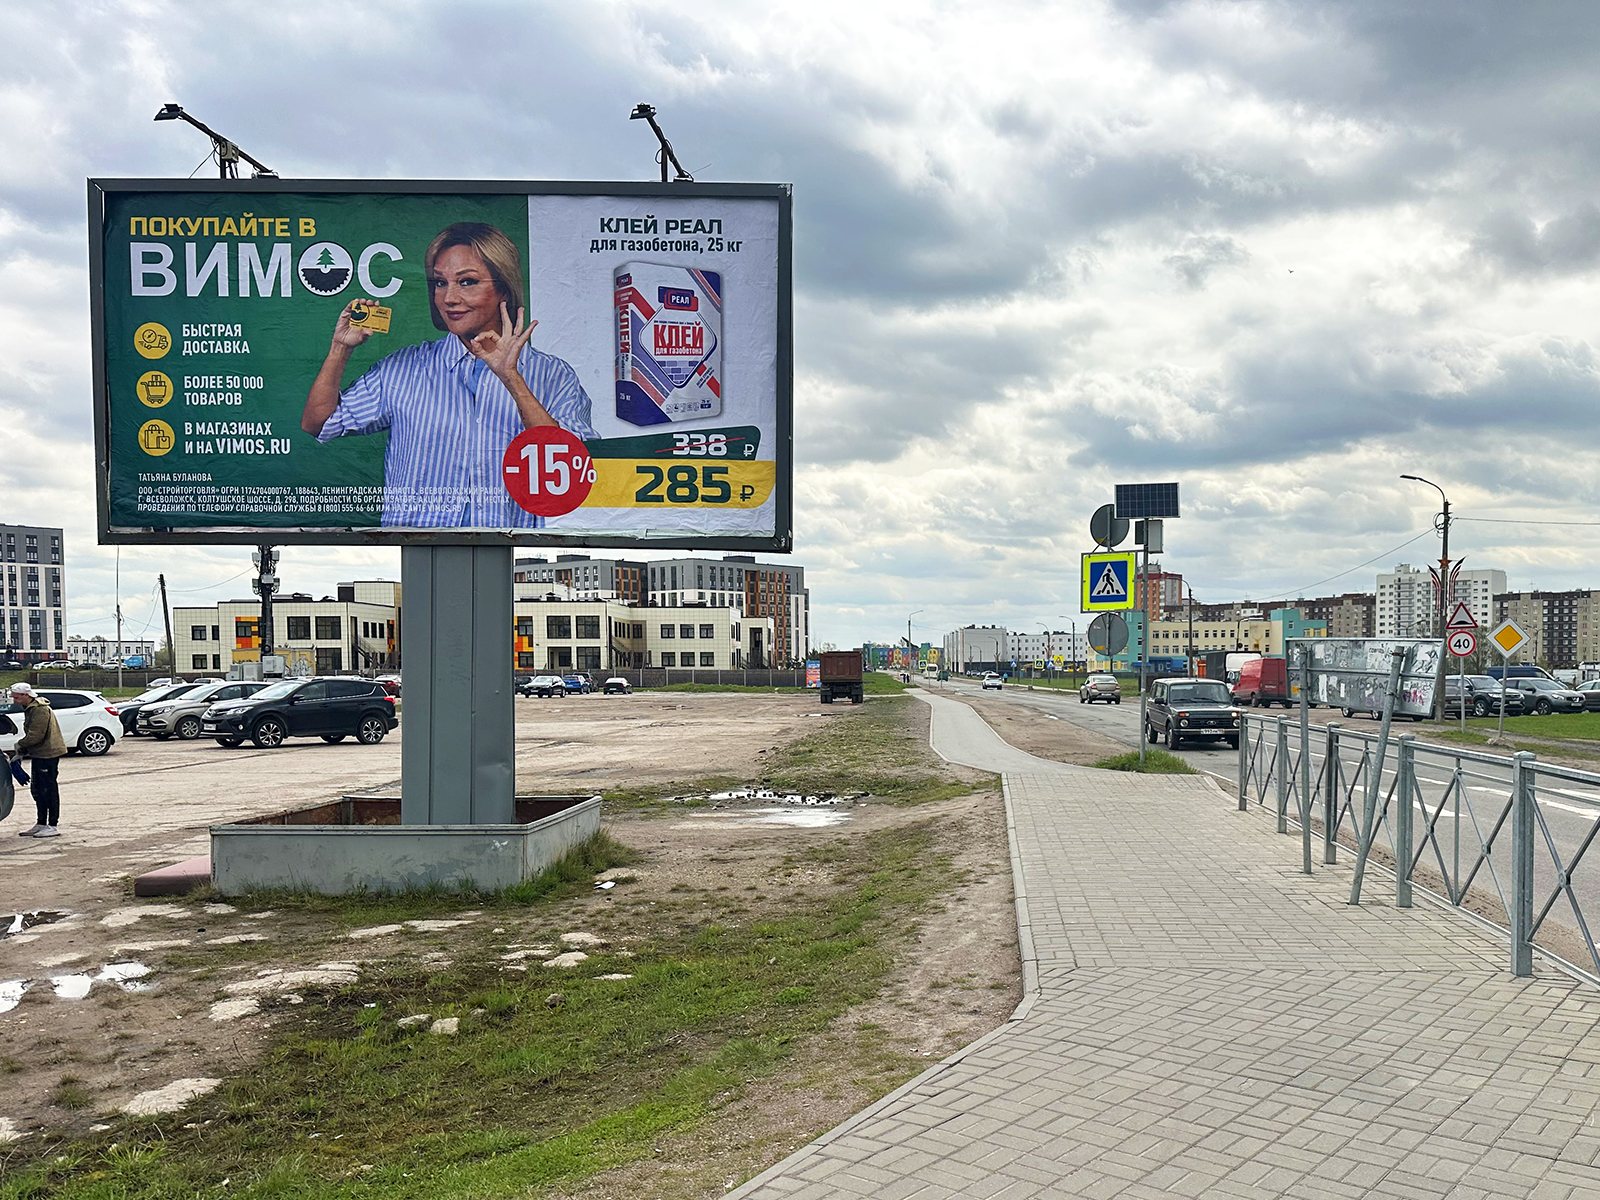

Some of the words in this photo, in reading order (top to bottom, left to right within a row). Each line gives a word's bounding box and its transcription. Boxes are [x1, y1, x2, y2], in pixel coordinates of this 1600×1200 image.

[130, 212, 290, 236] ПОКУПАЙТЕ
[299, 217, 316, 236] В
[600, 215, 658, 234] КЛЕЙ
[665, 219, 722, 235] РЕАЛ
[589, 238, 617, 253] для
[620, 237, 704, 254] газобетона,
[707, 237, 724, 252] 25
[727, 240, 743, 252] кг
[130, 240, 404, 298] ВИМОС
[671, 295, 690, 304] РЕАЛ
[182, 323, 242, 337] БЫСТРАЯ
[619, 303, 631, 353] КЛЕЙ
[653, 321, 704, 348] КЛЕЙ
[182, 340, 250, 356] ДОСТАВКА
[655, 347, 668, 355] для
[669, 346, 702, 355] газобетона
[184, 376, 223, 389] БОЛЕЕ
[226, 376, 241, 389] 50
[243, 376, 264, 389] 000
[184, 393, 242, 405] ТОВАРОВ
[184, 422, 193, 435] В
[195, 422, 272, 435] МАГАЗИНАХ
[185, 441, 193, 454] И
[196, 441, 213, 454] НА
[216, 438, 291, 454] VIMOS.RU
[672, 433, 728, 456] 338
[505, 443, 597, 495] -15%
[138, 473, 171, 482] ТАТЬЯНА
[172, 473, 212, 482] БУЛАНОВА
[635, 465, 731, 503] 285
[138, 486, 153, 495] ООО
[154, 485, 220, 495] «СТРОЙТОРГОВЛЯ»
[221, 486, 239, 495] ОГРН
[295, 486, 320, 496] 188643,
[321, 486, 382, 496] ЛЕНИНГРАДСКАЯ
[146, 495, 197, 504] ВСЕВОЛОЖСК,
[198, 495, 245, 504] КОЛТУШСКОЕ
[246, 495, 274, 504] ШОССЕ,
[300, 495, 352, 504] ПОДРОБНОСТИ
[352, 495, 362, 503] ОБ
[363, 495, 418, 504] ОРГАНИЗАТОРЕ
[138, 503, 185, 513] ПРОВЕДЕНИЯ
[186, 504, 196, 512] ПО
[197, 504, 234, 513] ТЕЛЕФОНУ
[235, 503, 283, 513] СПРАВОЧНОЙ
[284, 504, 316, 513] СЛУЖБЫ
[317, 504, 322, 512] 8
[323, 504, 341, 513] (800)
[341, 504, 374, 513] 555-66-66
[375, 504, 390, 512] ИЛИ
[1453, 638, 1470, 649] 40
